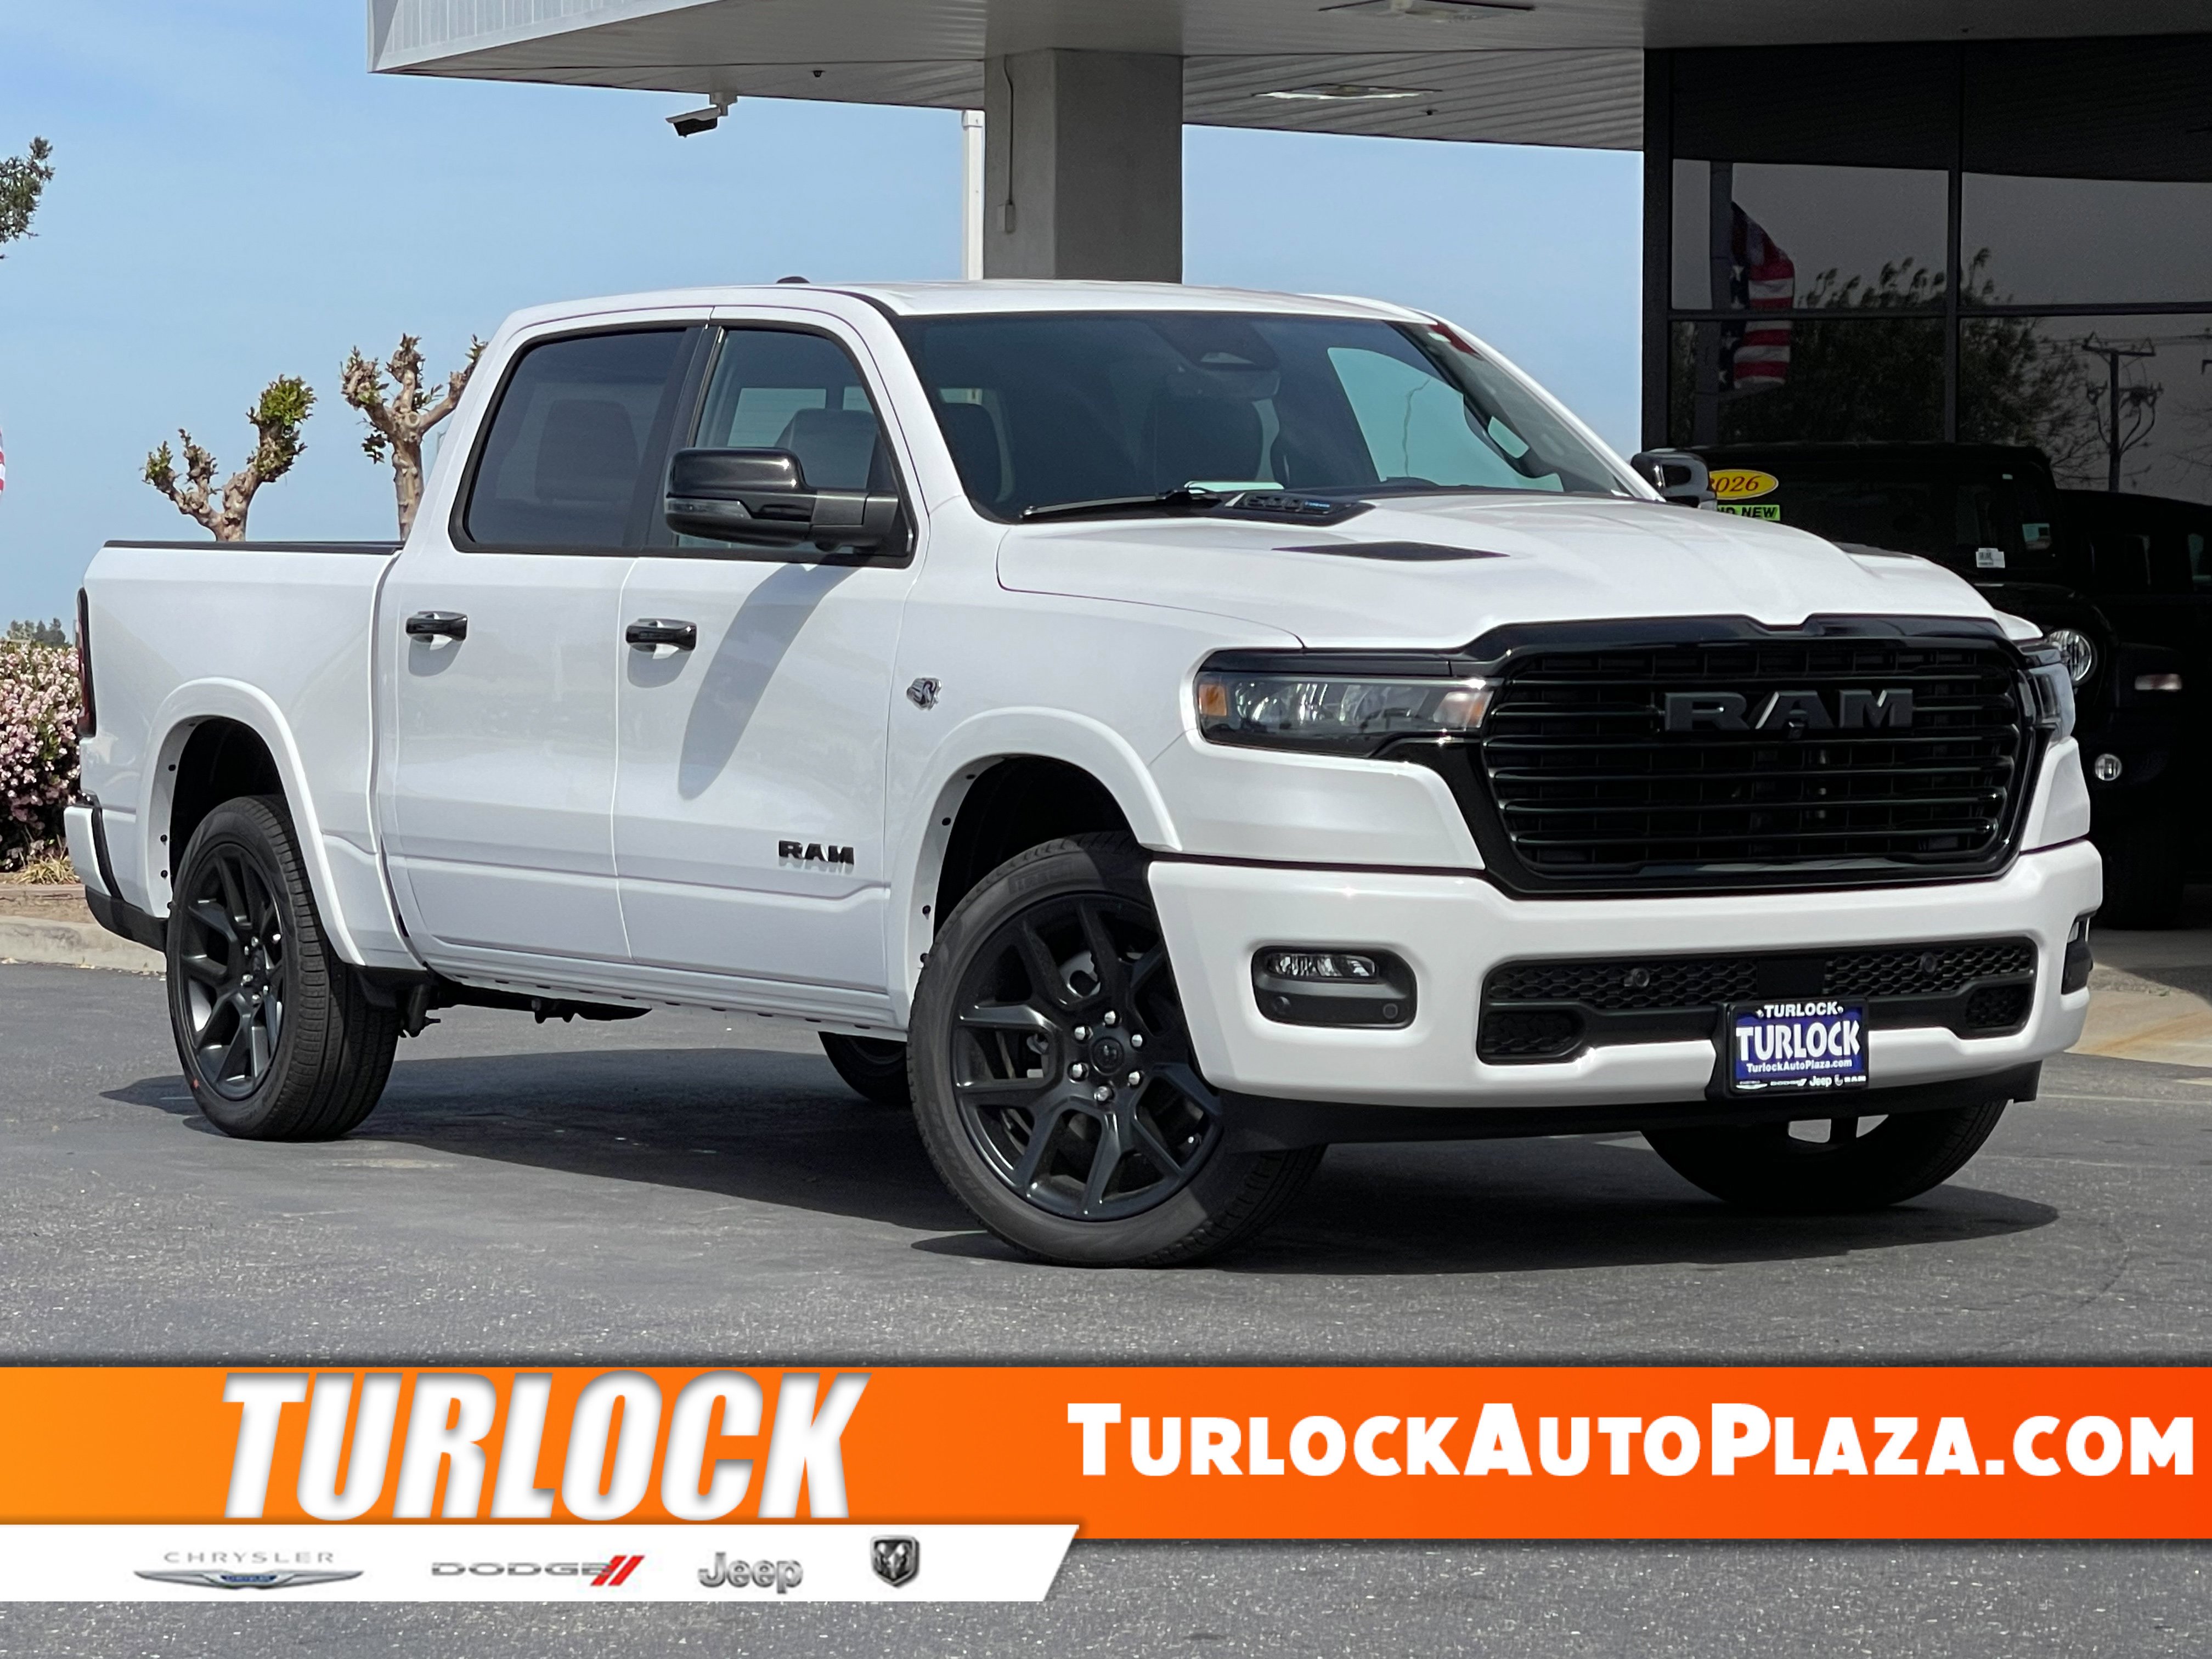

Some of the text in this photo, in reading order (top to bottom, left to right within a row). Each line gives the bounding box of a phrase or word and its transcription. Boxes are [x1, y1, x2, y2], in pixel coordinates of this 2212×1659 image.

[1710, 476, 1762, 493] 026
[1741, 507, 1776, 517] NEW
[1665, 689, 1913, 731] RAM
[779, 839, 855, 865] RAM
[1764, 1001, 1838, 1018] TURLOCK
[1736, 1020, 1860, 1061] TURLOCK
[1746, 1059, 1852, 1073] TurlockAutoPlaza.com
[1809, 1075, 1832, 1087] Jeep
